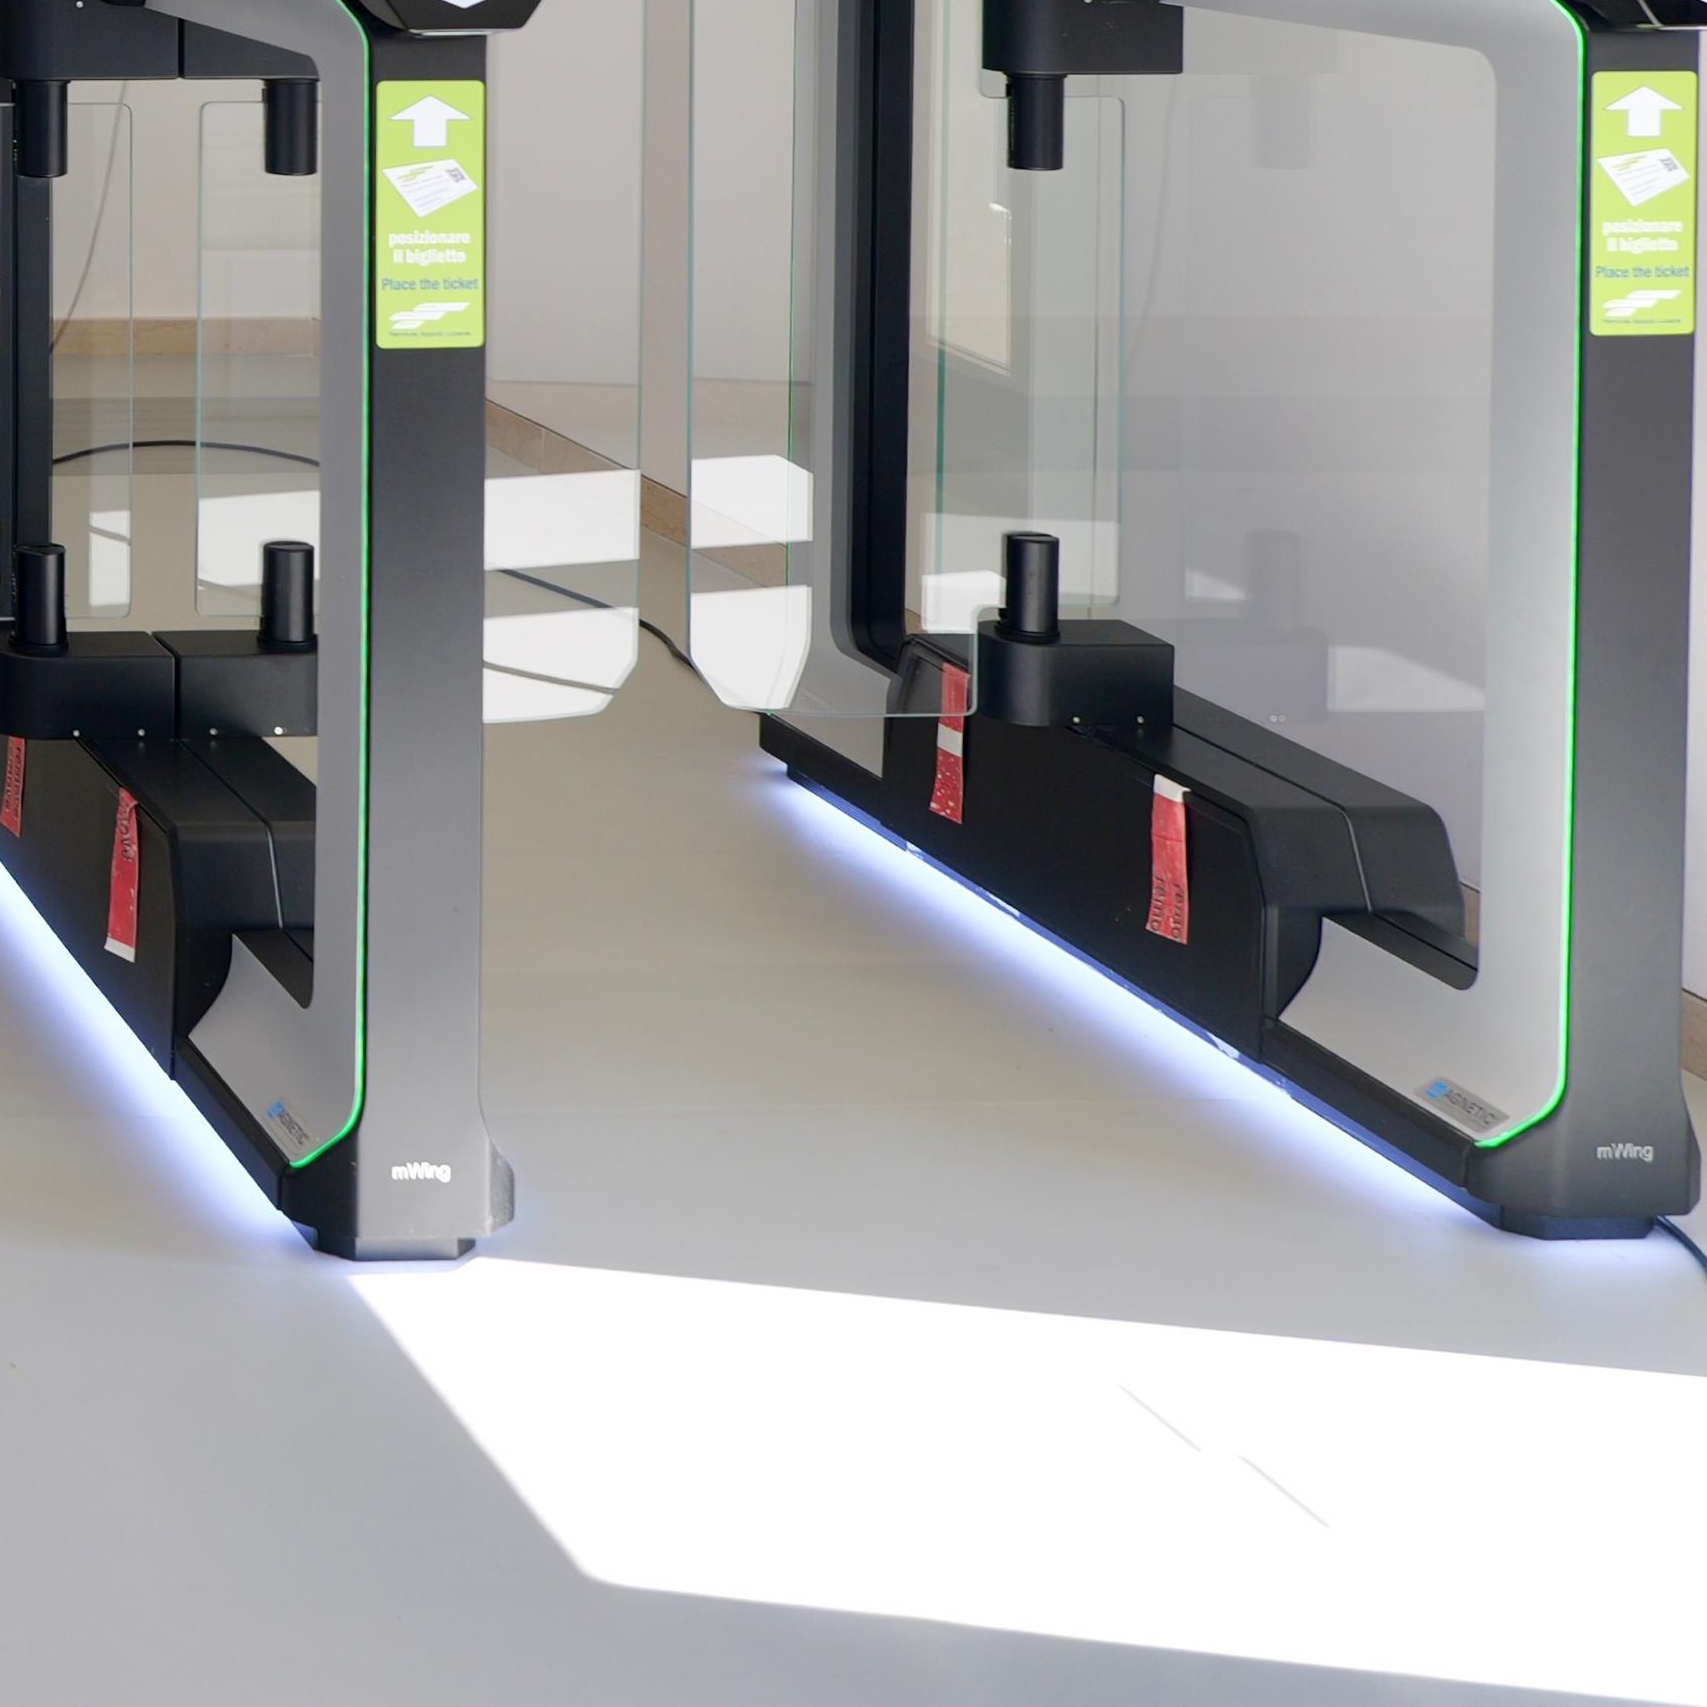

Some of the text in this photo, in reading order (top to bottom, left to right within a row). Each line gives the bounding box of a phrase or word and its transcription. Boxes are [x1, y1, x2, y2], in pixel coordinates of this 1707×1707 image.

[388, 230, 471, 247] posizionare
[1595, 264, 1690, 278] Place the ticket
[381, 277, 479, 291] Place the ticket
[1596, 1143, 1654, 1163] mWing
[391, 1161, 451, 1183] mWing
